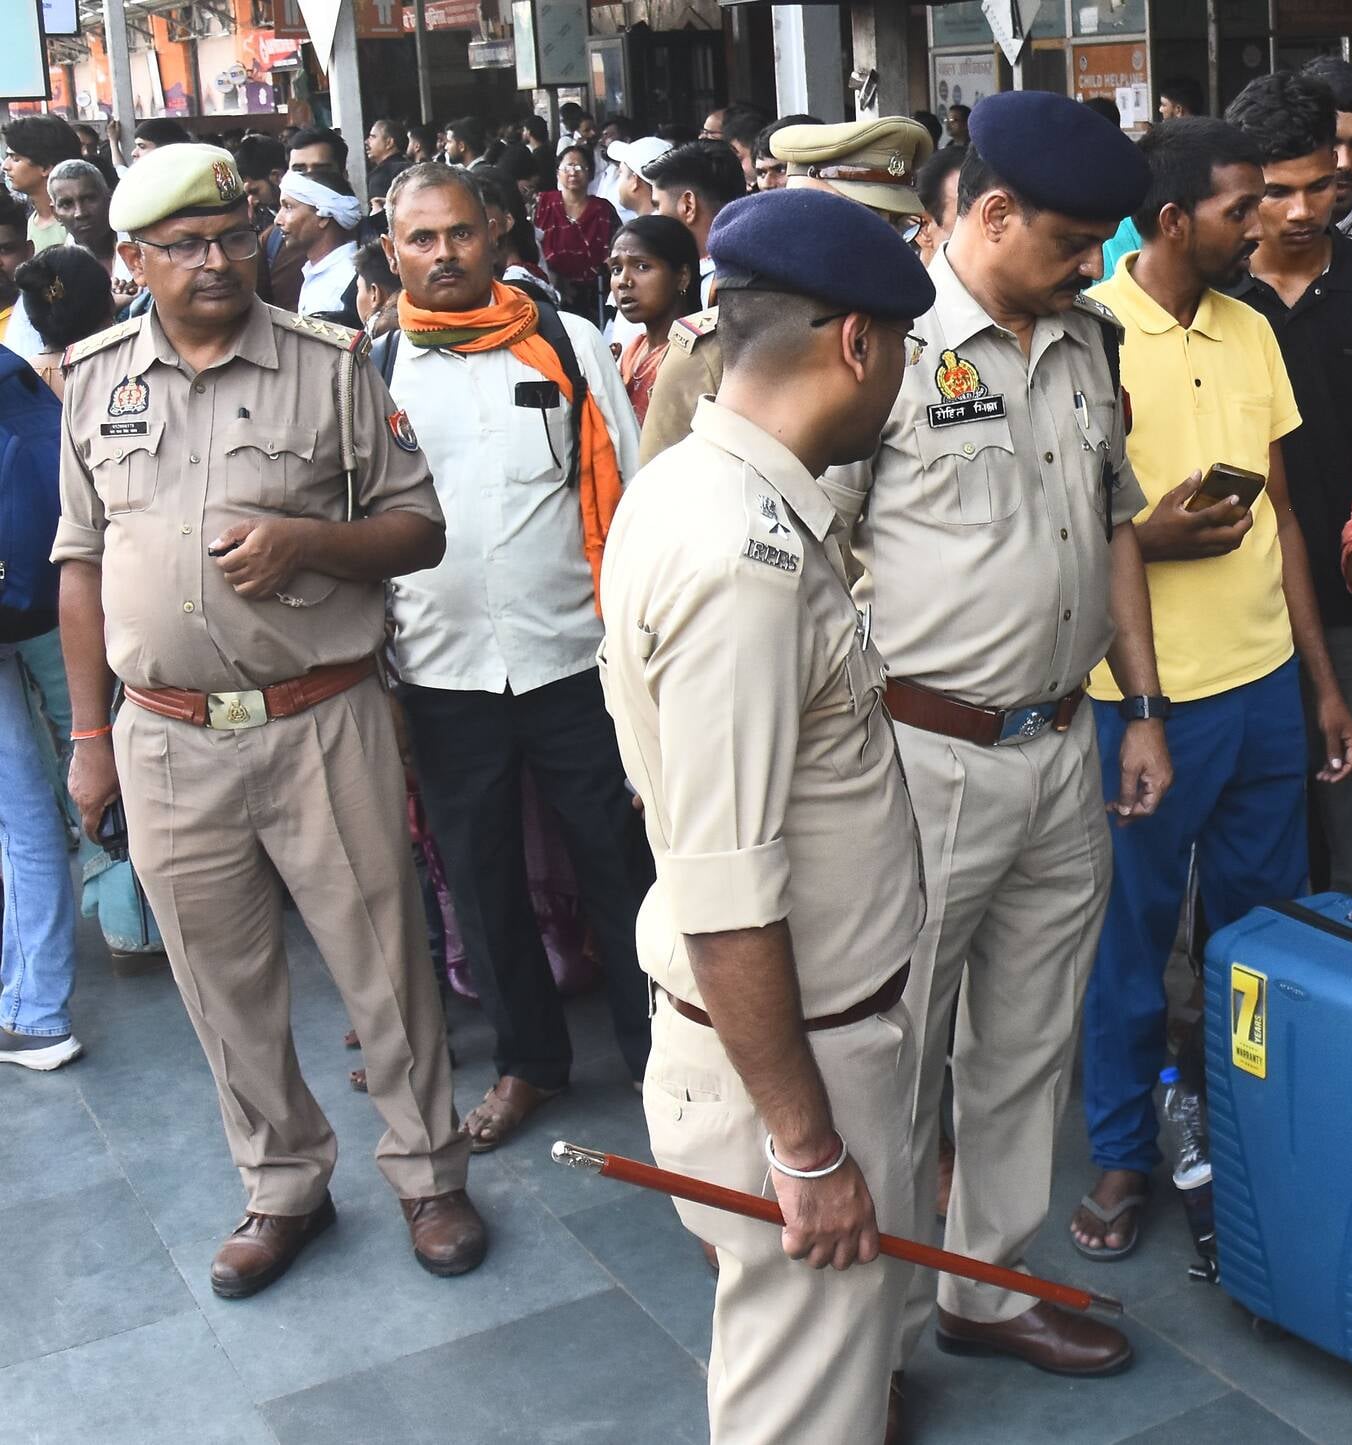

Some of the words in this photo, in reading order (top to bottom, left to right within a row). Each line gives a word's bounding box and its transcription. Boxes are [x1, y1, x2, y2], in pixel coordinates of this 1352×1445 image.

[1079, 74, 1103, 89] CHILD
[935, 406, 965, 420] रोहित
[1232, 966, 1260, 1042] 7
[1253, 1015, 1263, 1045] YEARS
[1236, 1046, 1264, 1065] WARRANTY
